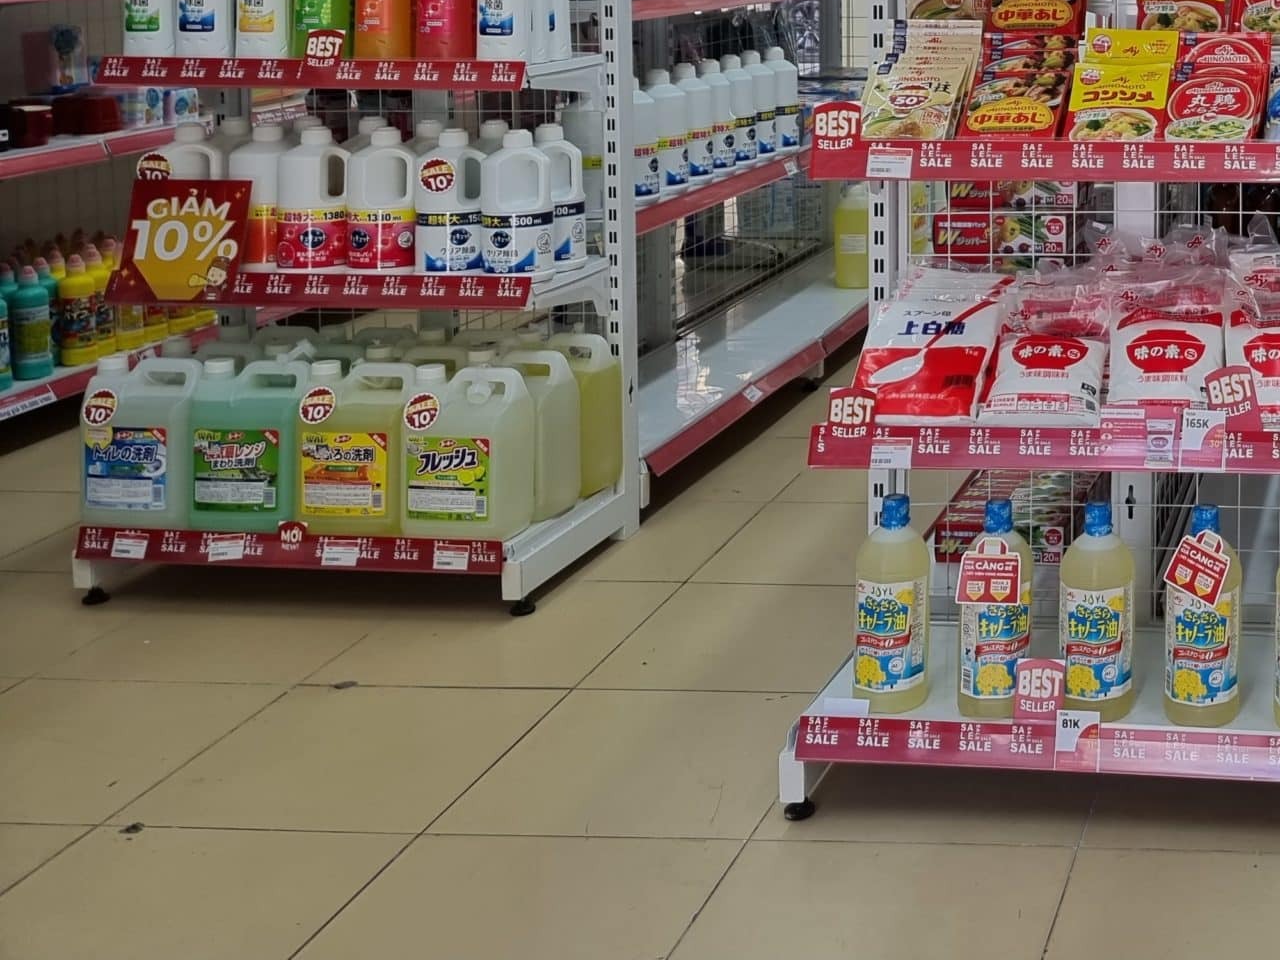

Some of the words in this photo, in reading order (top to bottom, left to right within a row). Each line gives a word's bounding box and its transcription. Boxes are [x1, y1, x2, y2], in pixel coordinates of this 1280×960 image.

[998, 9, 1066, 21] 中華あじ
[307, 37, 342, 60] BEST
[307, 58, 335, 68] SELLER
[104, 68, 129, 77] SALE
[815, 110, 859, 137] BEST
[973, 114, 1045, 124] 中華あじ
[818, 138, 853, 150] SELLER
[920, 158, 952, 167] SALE
[147, 188, 231, 220] GIẢM
[131, 219, 238, 261] 10%
[266, 286, 291, 294] SALE
[897, 320, 968, 336] 上白糖
[1209, 373, 1252, 405] BEST
[830, 397, 875, 424] BEST
[1185, 418, 1210, 429] 165K
[832, 426, 866, 437] SELLER
[918, 444, 950, 454] SALE
[417, 448, 479, 476] フレッシュ
[280, 527, 302, 544] MỚI
[84, 541, 109, 550] SALE
[1189, 549, 1216, 568] CÀNG
[976, 560, 1004, 570] CÀNG
[864, 596, 899, 611] さらさら
[858, 612, 907, 632] キャノーラ油
[1182, 610, 1218, 626] さらさら
[1018, 668, 1063, 697] BEST
[1019, 700, 1055, 712] SELLER
[1062, 719, 1080, 729] 81K
[805, 734, 838, 745] SALE
